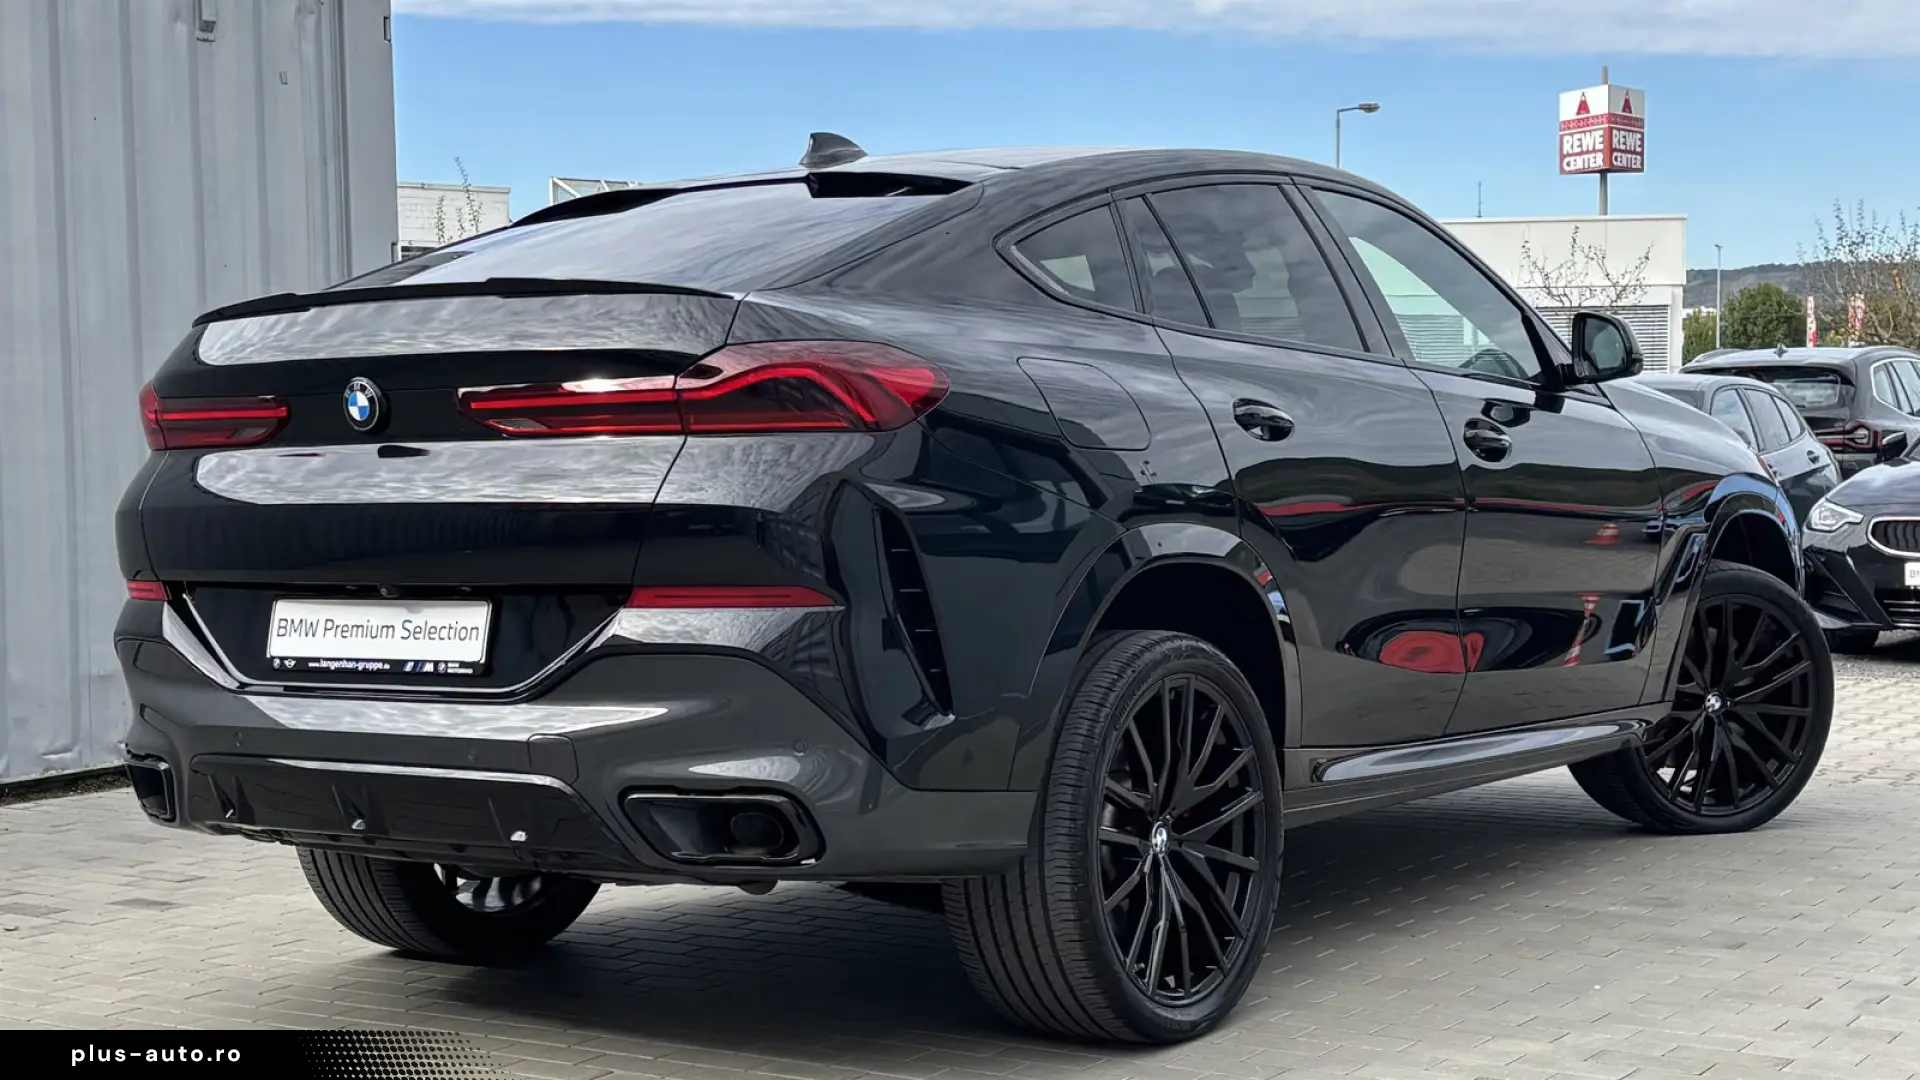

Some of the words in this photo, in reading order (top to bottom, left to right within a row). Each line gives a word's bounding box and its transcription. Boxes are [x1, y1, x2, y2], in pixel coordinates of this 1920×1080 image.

[1563, 129, 1604, 155] REWE
[1612, 129, 1642, 152] REWE
[1563, 152, 1604, 171] CENTER
[1612, 151, 1642, 169] CENTER
[276, 618, 320, 638] BMW
[323, 618, 396, 640] Premium
[400, 619, 480, 642] Selection
